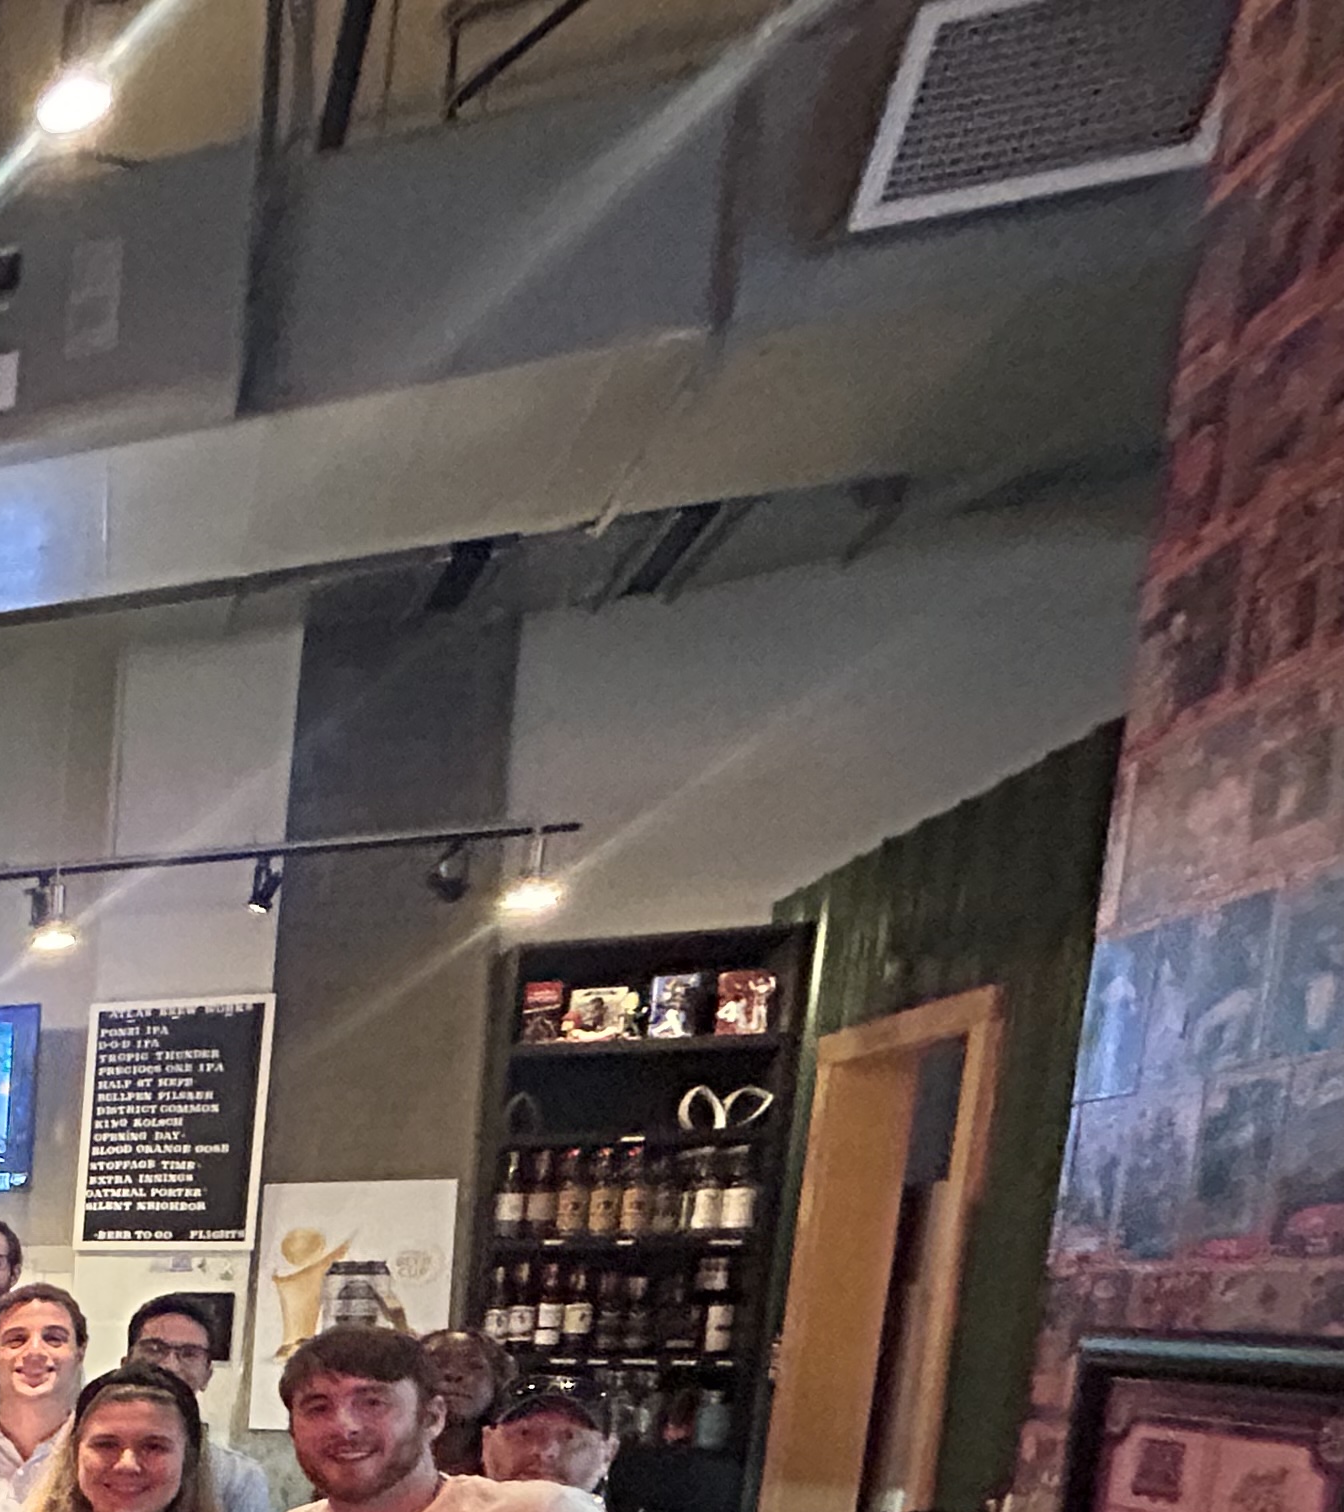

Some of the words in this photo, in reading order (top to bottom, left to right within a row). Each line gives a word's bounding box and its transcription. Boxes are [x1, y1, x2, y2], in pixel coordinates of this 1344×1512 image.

[145, 1026, 169, 1035] IPA
[98, 1052, 149, 1063] TROPIC
[155, 1049, 220, 1060] THUNDER
[198, 1063, 224, 1073] IPA
[97, 1078, 132, 1090] HALF
[97, 1092, 152, 1101] BULLPEN
[96, 1105, 157, 1116] DISTRICT
[159, 1104, 220, 1114] COMMON
[93, 1130, 147, 1142] OPENING
[91, 1144, 132, 1155] BLOOD
[136, 1144, 192, 1154] ORANGE
[89, 1160, 156, 1170] STOPPAGE
[89, 1175, 133, 1185] EXTRA
[85, 1188, 146, 1198] OATMEAL
[85, 1202, 132, 1211] SILENT
[134, 1230, 153, 1240] TO
